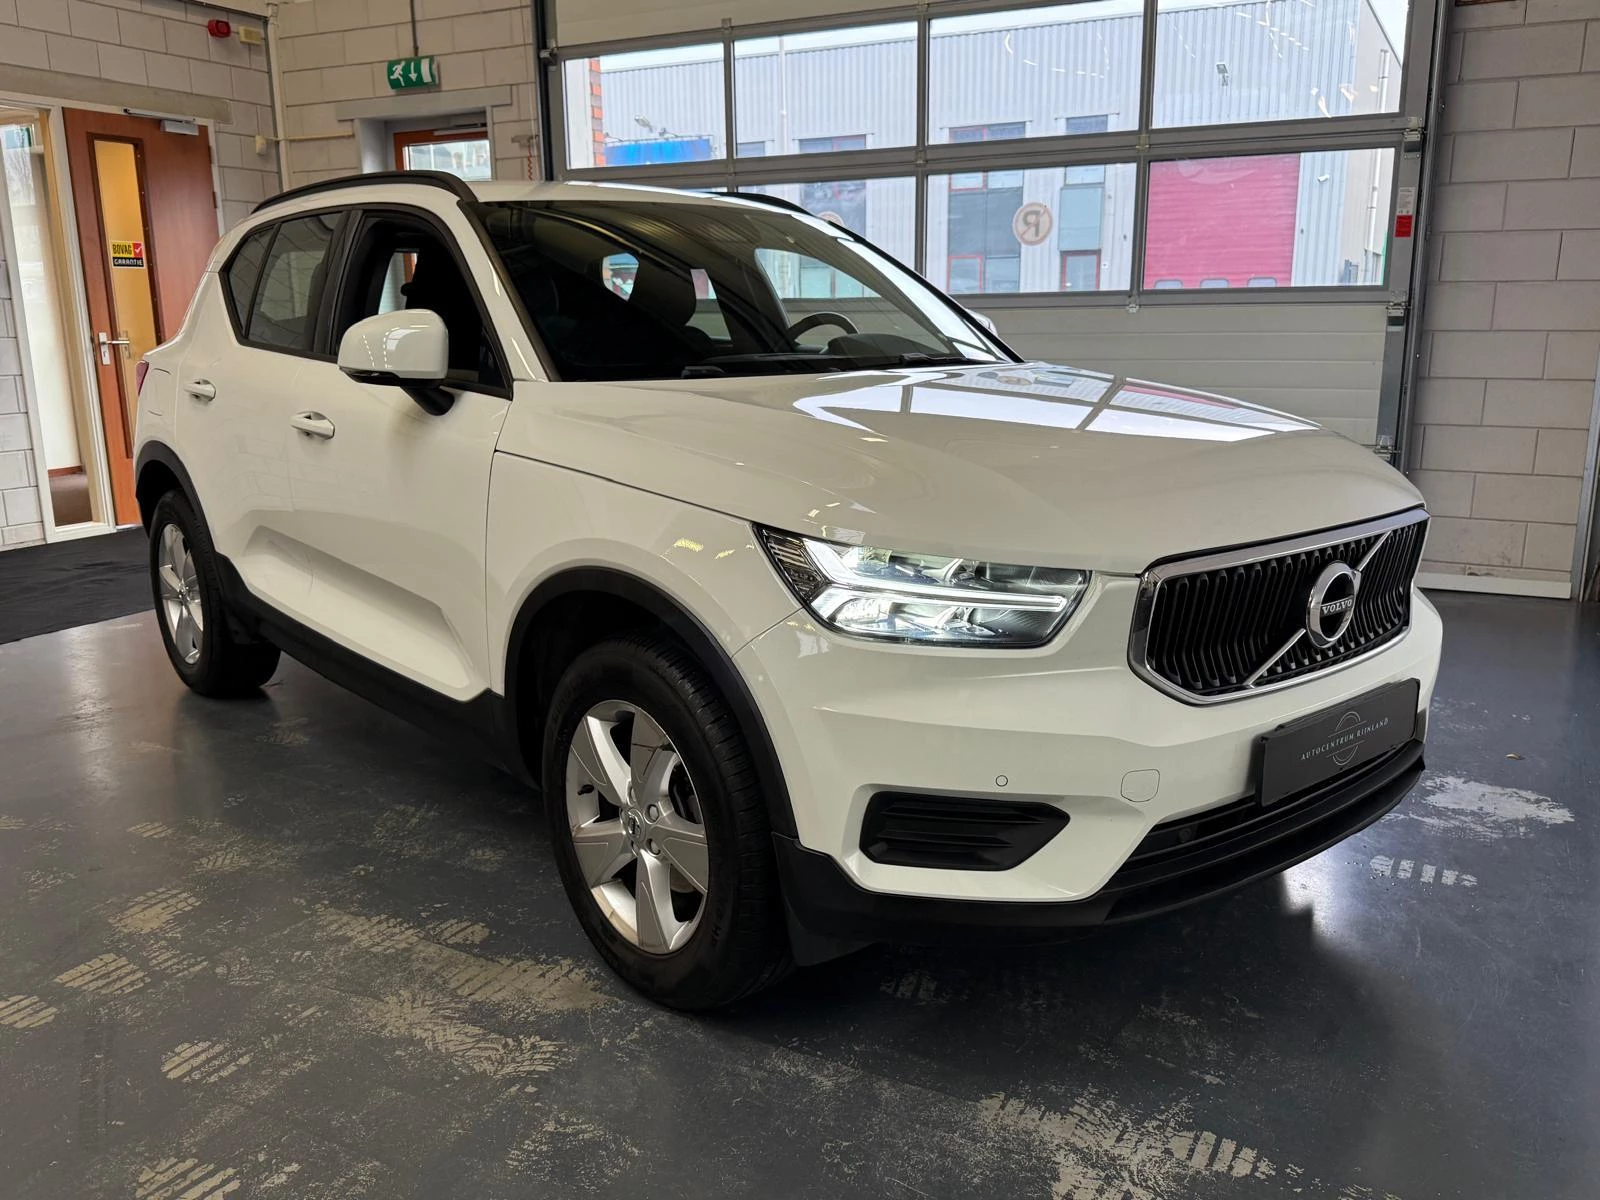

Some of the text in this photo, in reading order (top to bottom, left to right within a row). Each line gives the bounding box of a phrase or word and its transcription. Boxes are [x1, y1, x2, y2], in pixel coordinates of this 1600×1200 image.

[112, 243, 132, 256] BOVAG
[1321, 599, 1353, 615] VOLVO
[1301, 733, 1354, 760] AUTOCENTRUM
